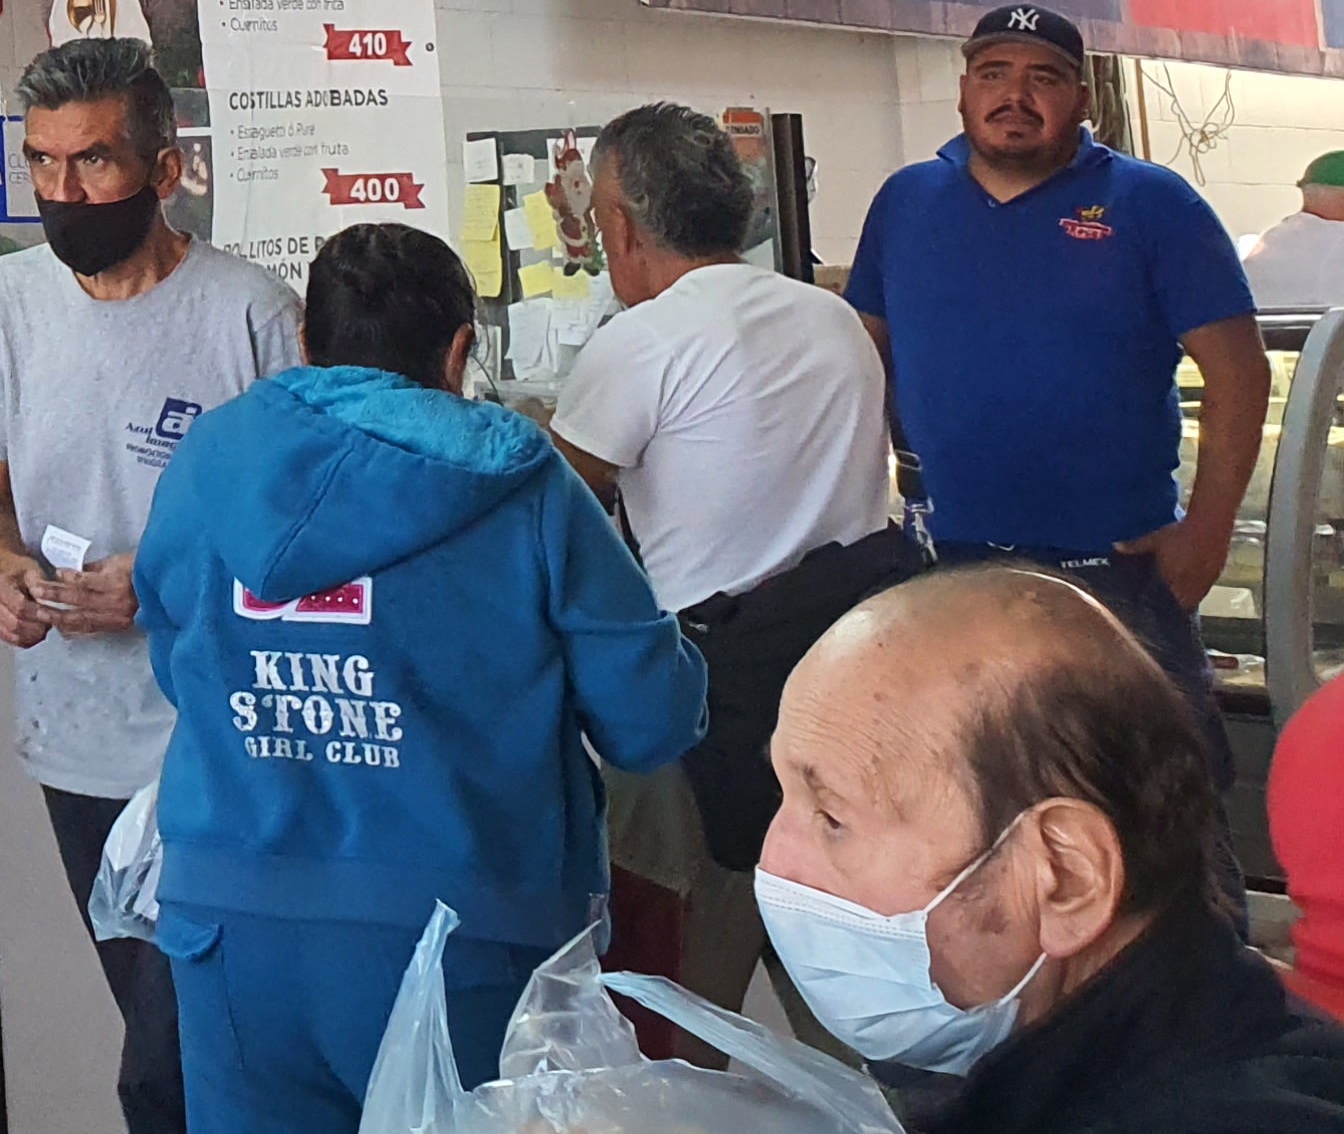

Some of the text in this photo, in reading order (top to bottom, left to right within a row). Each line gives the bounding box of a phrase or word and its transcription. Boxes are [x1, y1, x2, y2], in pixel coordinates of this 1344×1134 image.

[348, 32, 388, 57] 410
[229, 88, 389, 111] COSTILLAS ADOBADAS
[349, 177, 400, 202] 400
[287, 236, 309, 255] DE
[1060, 557, 1111, 569] TELMEX
[249, 650, 375, 697] KING
[229, 691, 403, 741] STONE
[244, 735, 401, 768] GIRL CLUB
